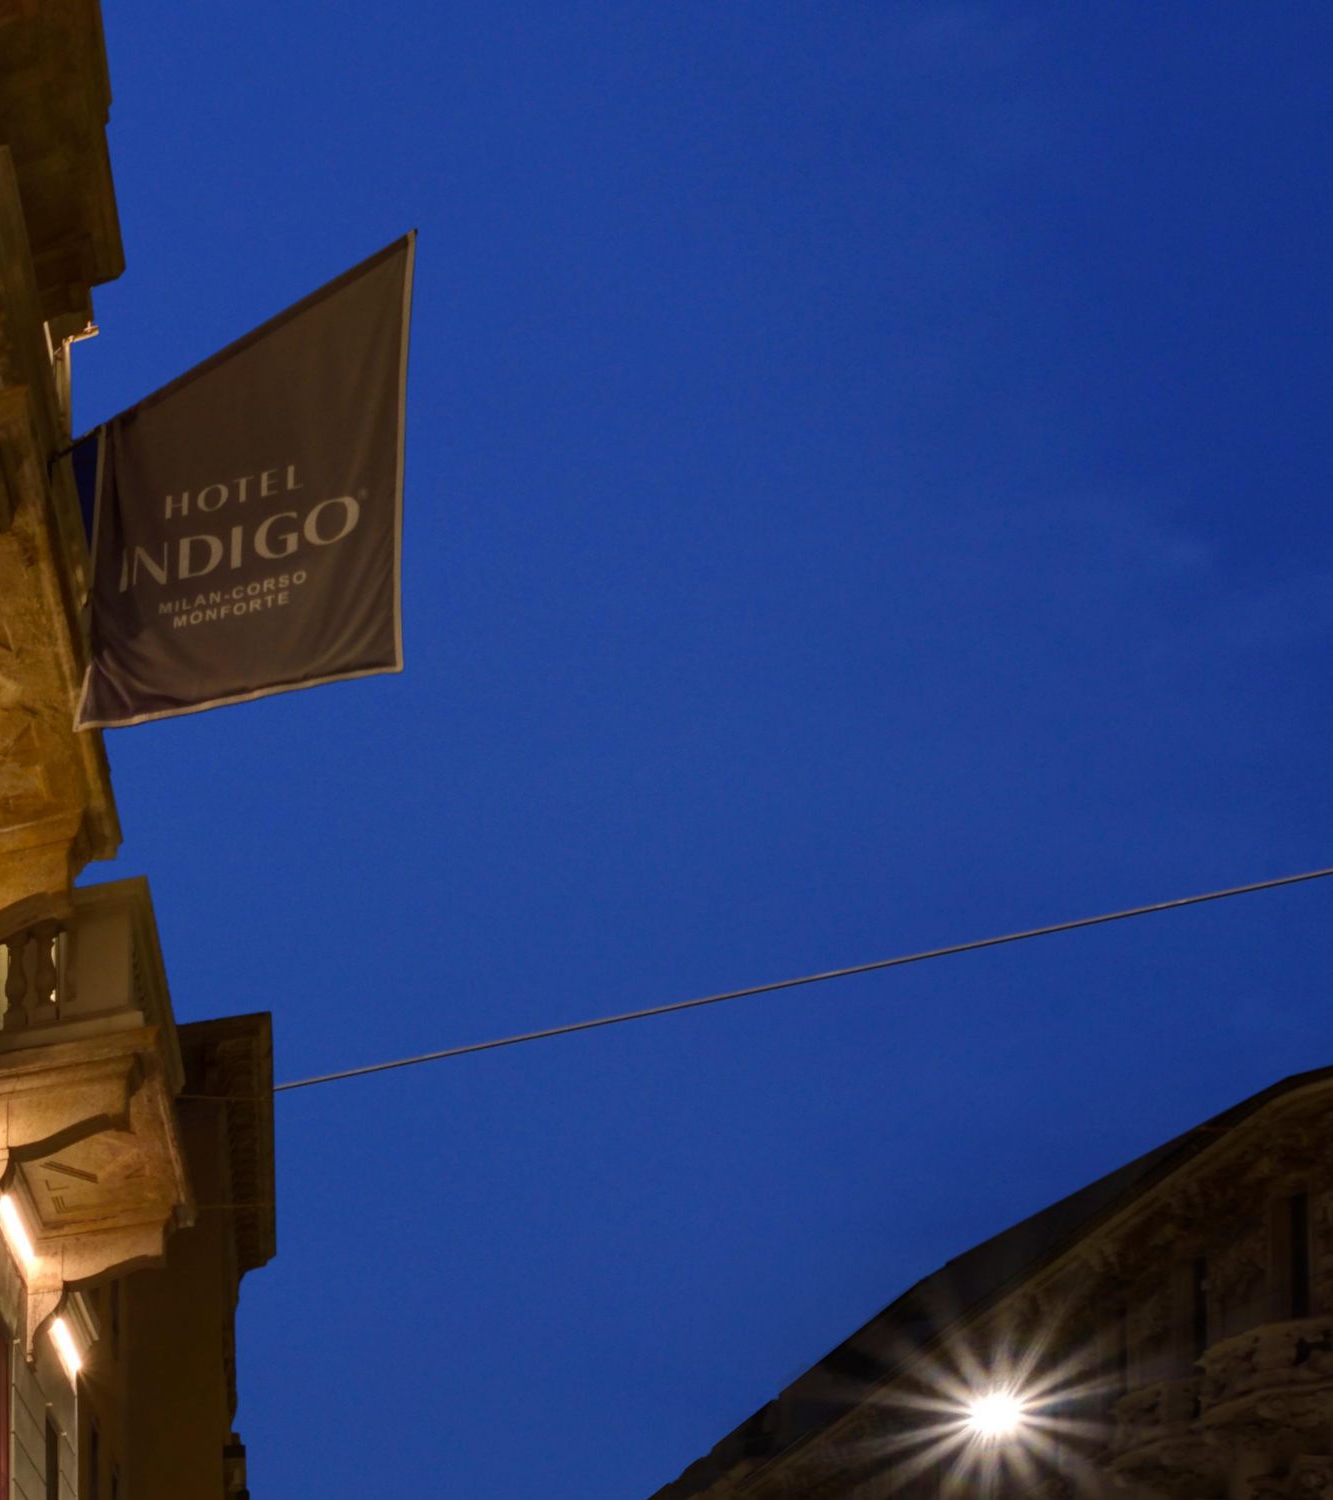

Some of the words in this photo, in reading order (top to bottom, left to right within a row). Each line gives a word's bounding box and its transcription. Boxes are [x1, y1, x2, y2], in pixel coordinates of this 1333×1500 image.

[164, 464, 305, 521] HOTEL
[119, 495, 361, 594] INDIGO
[158, 569, 308, 615] MILAN-CORSO
[172, 591, 290, 630] MONFORTE
